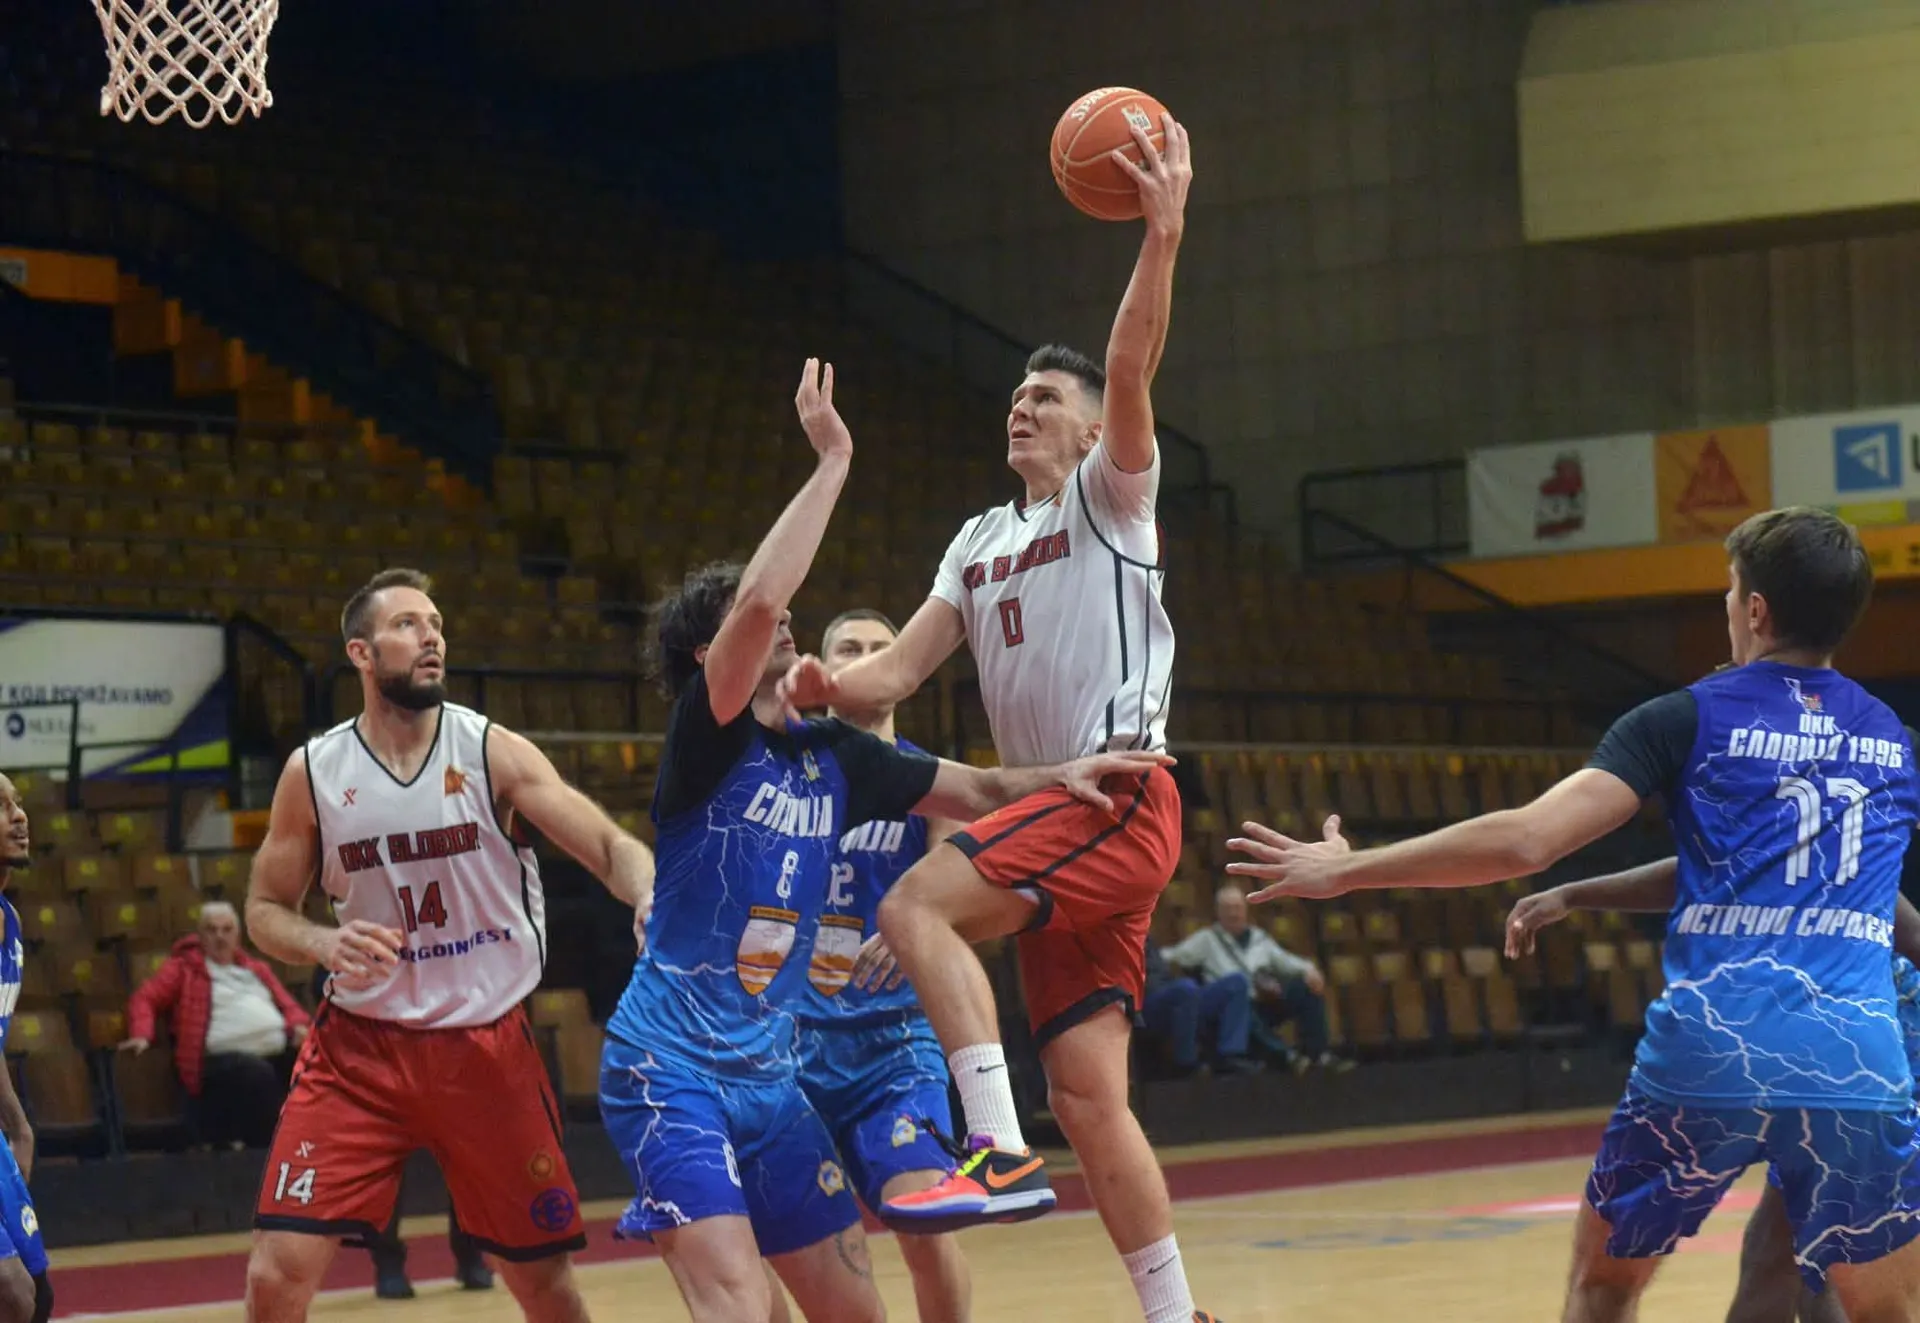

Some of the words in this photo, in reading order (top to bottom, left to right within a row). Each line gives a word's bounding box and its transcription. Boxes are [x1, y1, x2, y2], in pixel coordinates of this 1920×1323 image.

[991, 528, 1071, 582] SLBODA
[1848, 735, 1903, 769] 1996
[1775, 775, 1871, 886] 77
[338, 837, 384, 873] OKK
[398, 881, 448, 934] 14
[273, 1162, 317, 1206] 14
